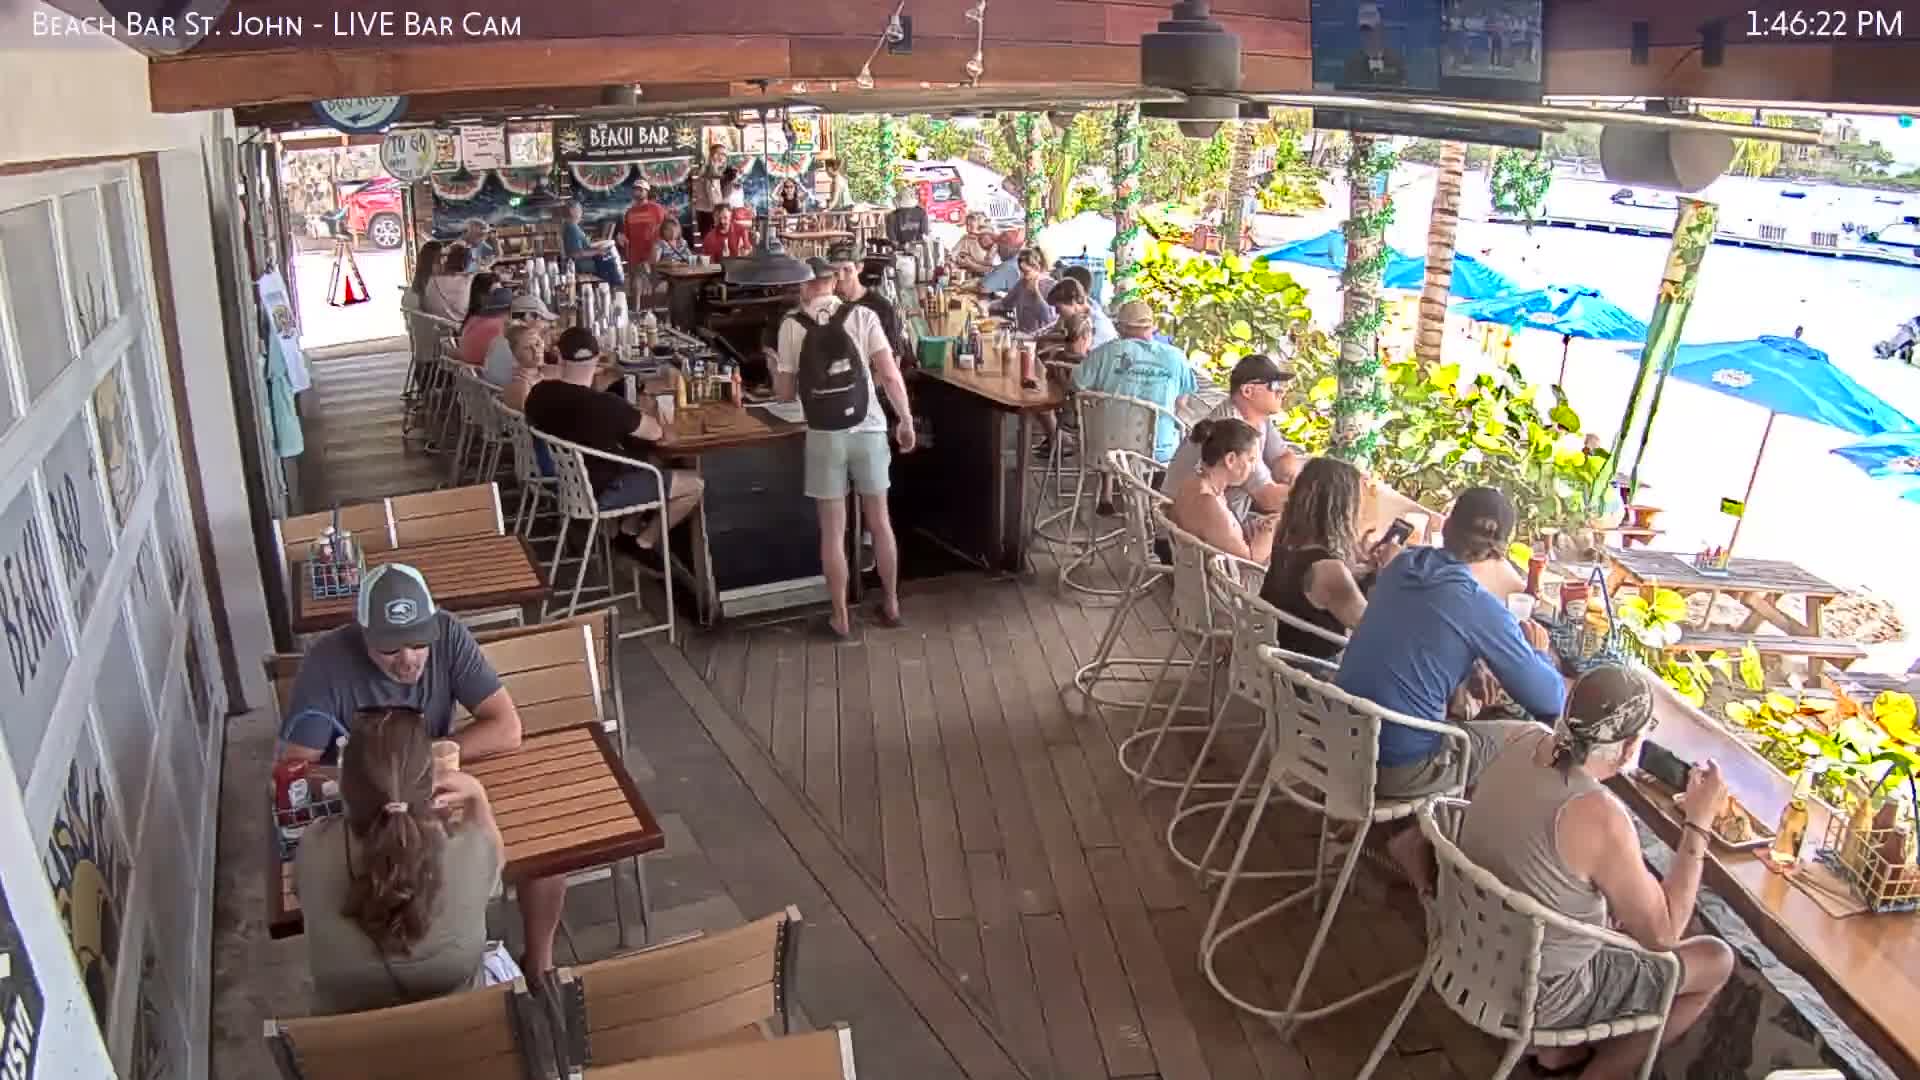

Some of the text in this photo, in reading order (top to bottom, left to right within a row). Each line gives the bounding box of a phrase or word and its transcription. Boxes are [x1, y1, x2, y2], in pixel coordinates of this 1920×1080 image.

[389, 134, 426, 153] TO GO
[589, 125, 670, 147] BEACH BAR
